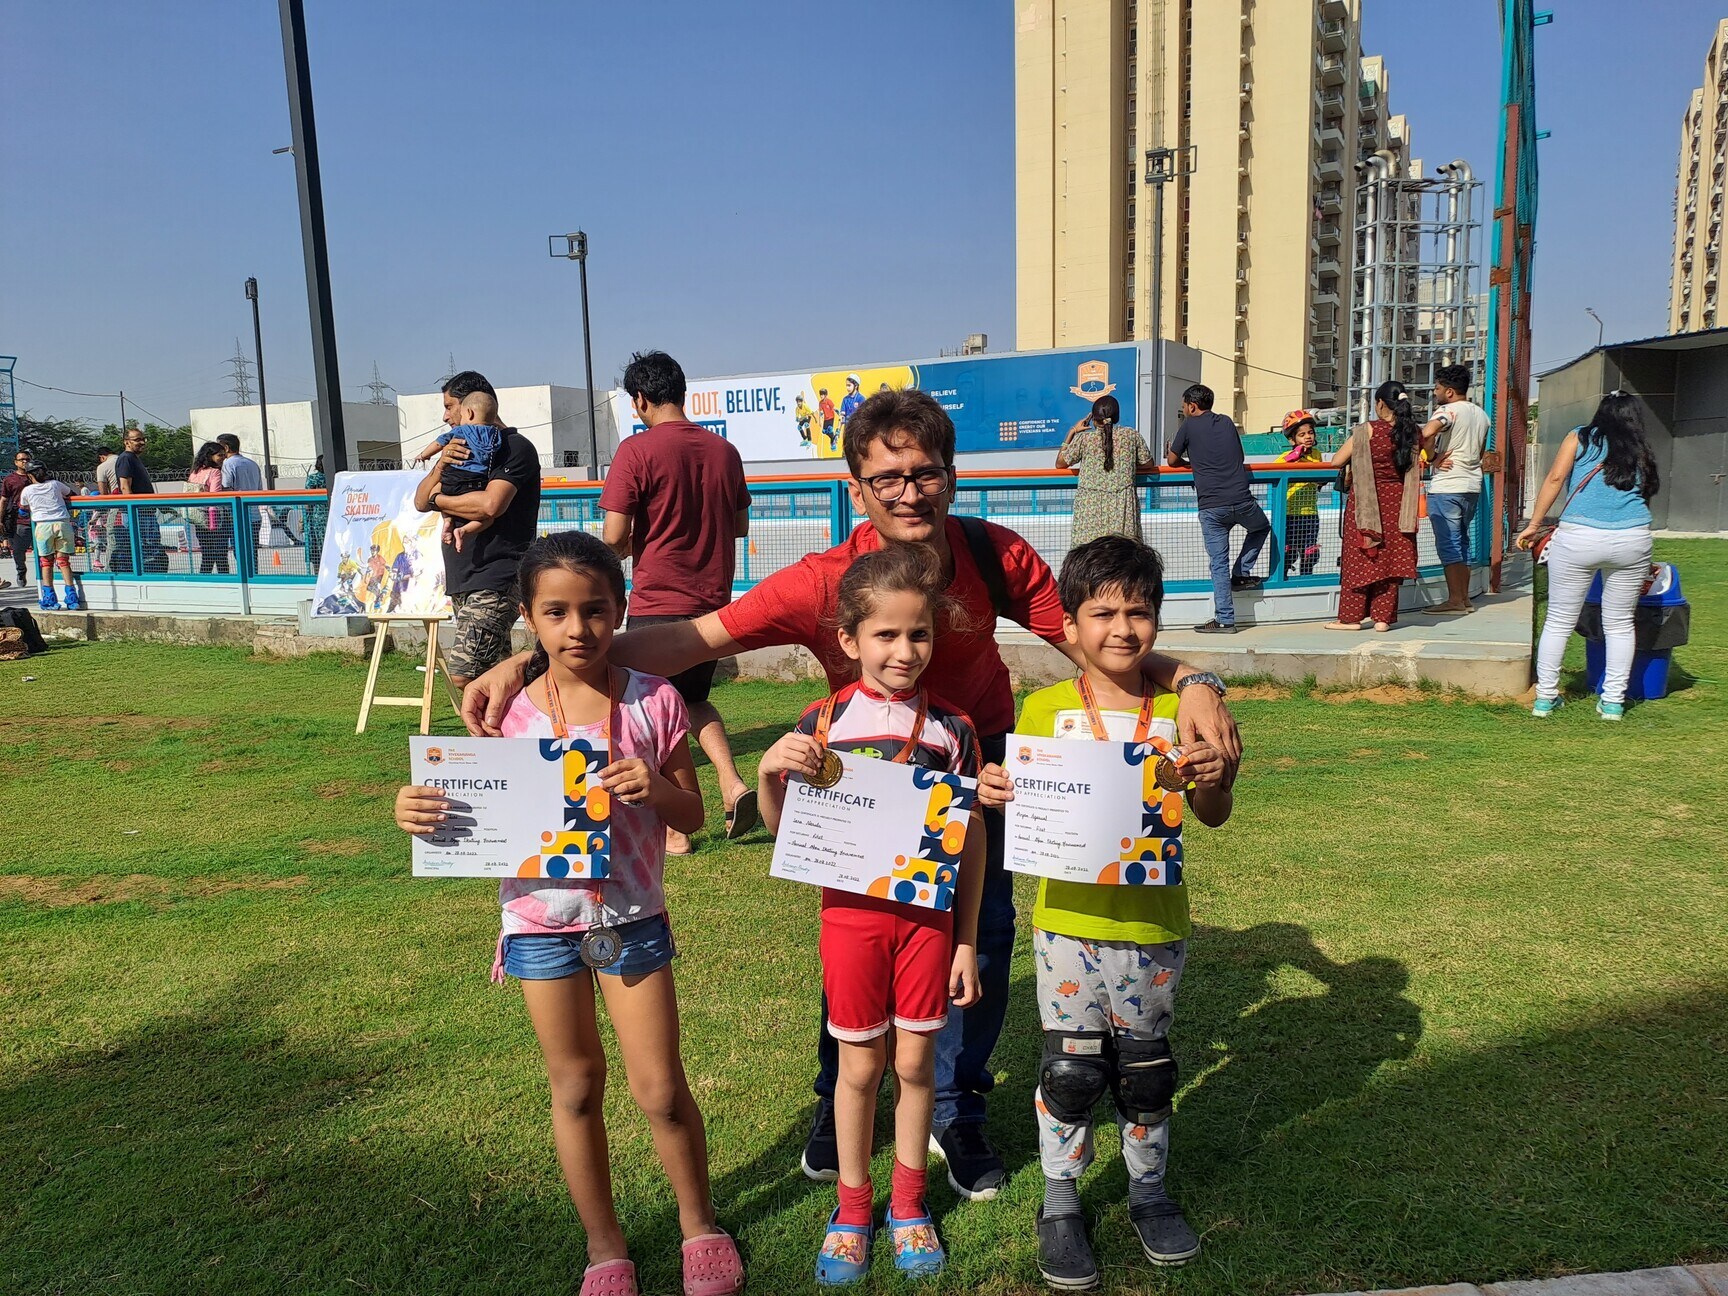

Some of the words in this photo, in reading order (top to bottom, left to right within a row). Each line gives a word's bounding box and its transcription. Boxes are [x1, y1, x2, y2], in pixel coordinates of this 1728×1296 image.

[692, 391, 722, 418] OUT,
[726, 387, 786, 414] BELIEVE,
[346, 493, 368, 503] OPEN
[345, 504, 380, 515] SKATING
[424, 778, 508, 790] CERTIFICATE
[1014, 777, 1091, 794] CERTIFICATE
[798, 785, 876, 809] CERTIFICATE
[1024, 792, 1066, 800] APPRECIATION
[807, 800, 851, 811] APPRECIATION
